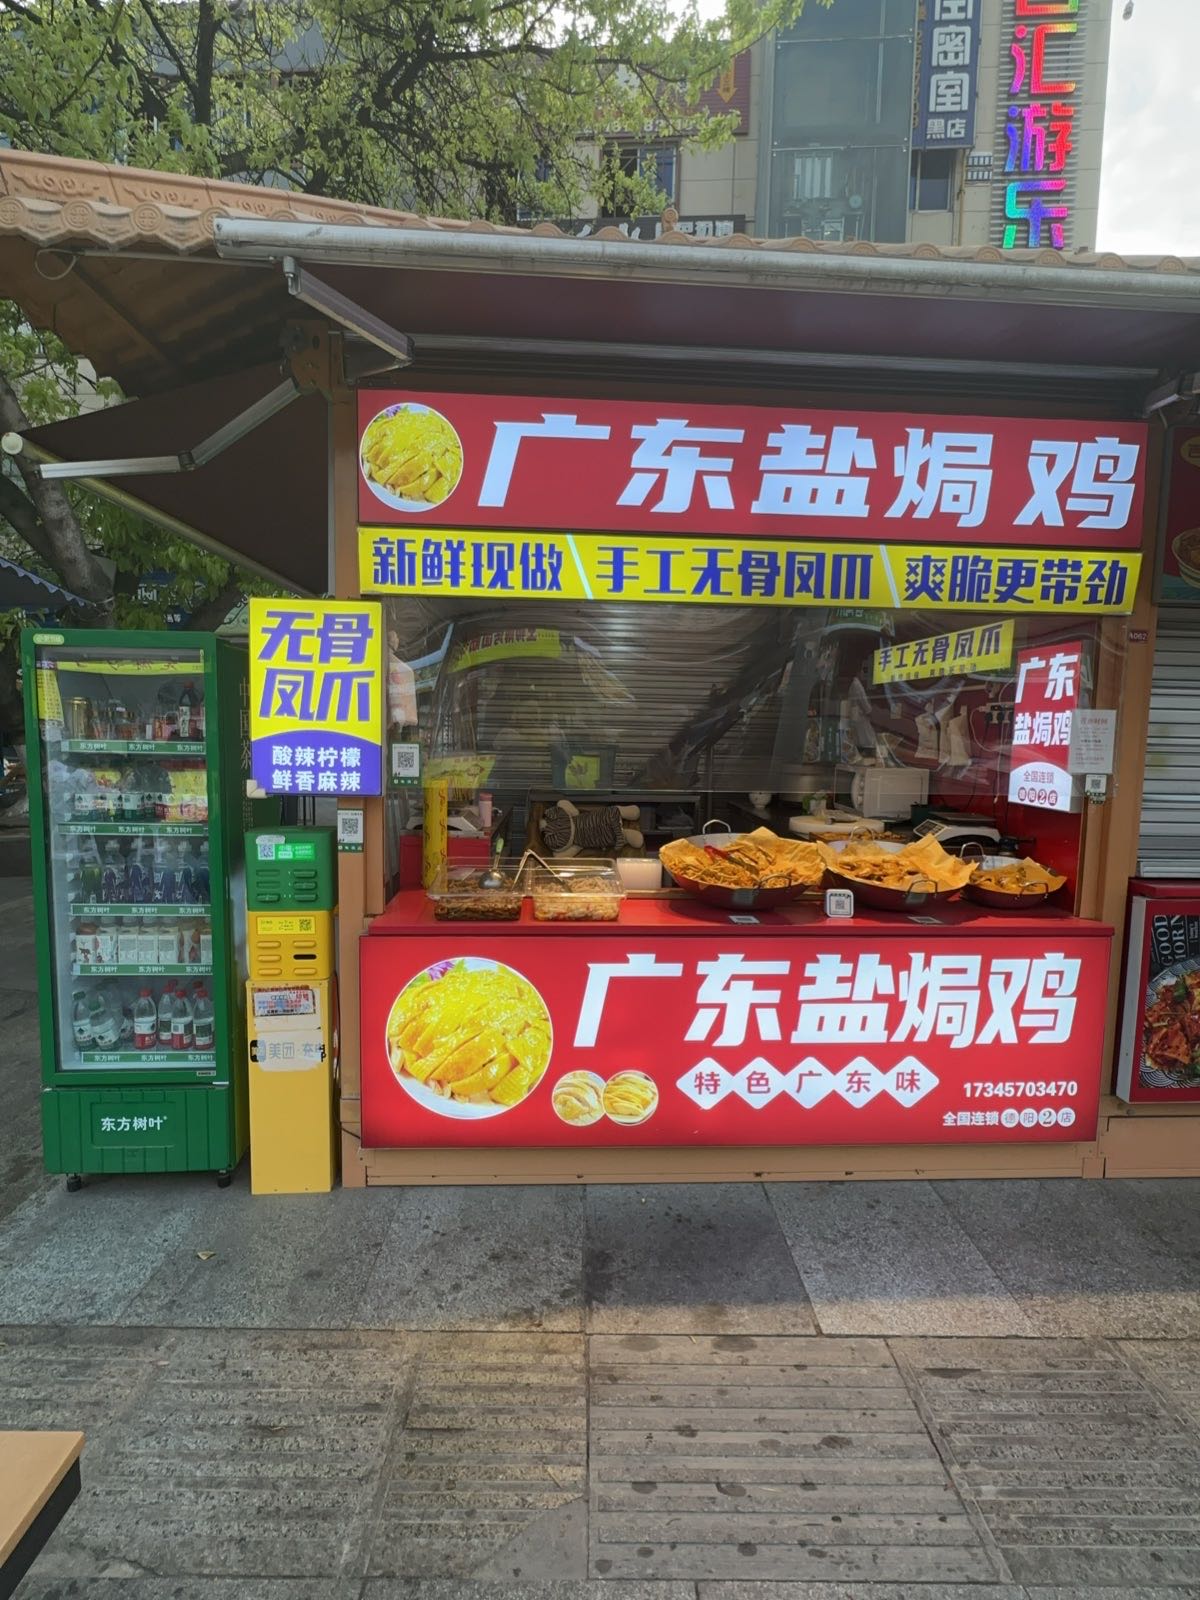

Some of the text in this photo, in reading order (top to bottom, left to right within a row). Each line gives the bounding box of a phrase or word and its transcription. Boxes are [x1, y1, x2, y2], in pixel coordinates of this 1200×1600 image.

[926, 118, 967, 139] 黑店
[1003, 0, 1079, 249] 汇游乐
[477, 413, 1141, 530] 广东盐焗鸡
[371, 536, 1130, 607] 新鲜现做 手工无骨凤爪 爽脆更带劲
[257, 610, 375, 665] 无骨
[878, 623, 1003, 672] 手工无骨凤爪
[258, 667, 376, 722] 凤爪
[1014, 652, 1079, 704] 广东
[1012, 709, 1072, 748] 盐焗鸡
[271, 745, 361, 768] 酸辣柠檬
[271, 769, 361, 792] 鲜香麻辣
[1154, 914, 1174, 966] GOOD
[573, 952, 1082, 1049] 广东盐焗鸡
[694, 1069, 922, 1095] 特色广东味
[963, 1081, 1078, 1098] 17345703470
[100, 1116, 164, 1132] 东方树叶
[942, 1111, 999, 1126] 全国连锁
